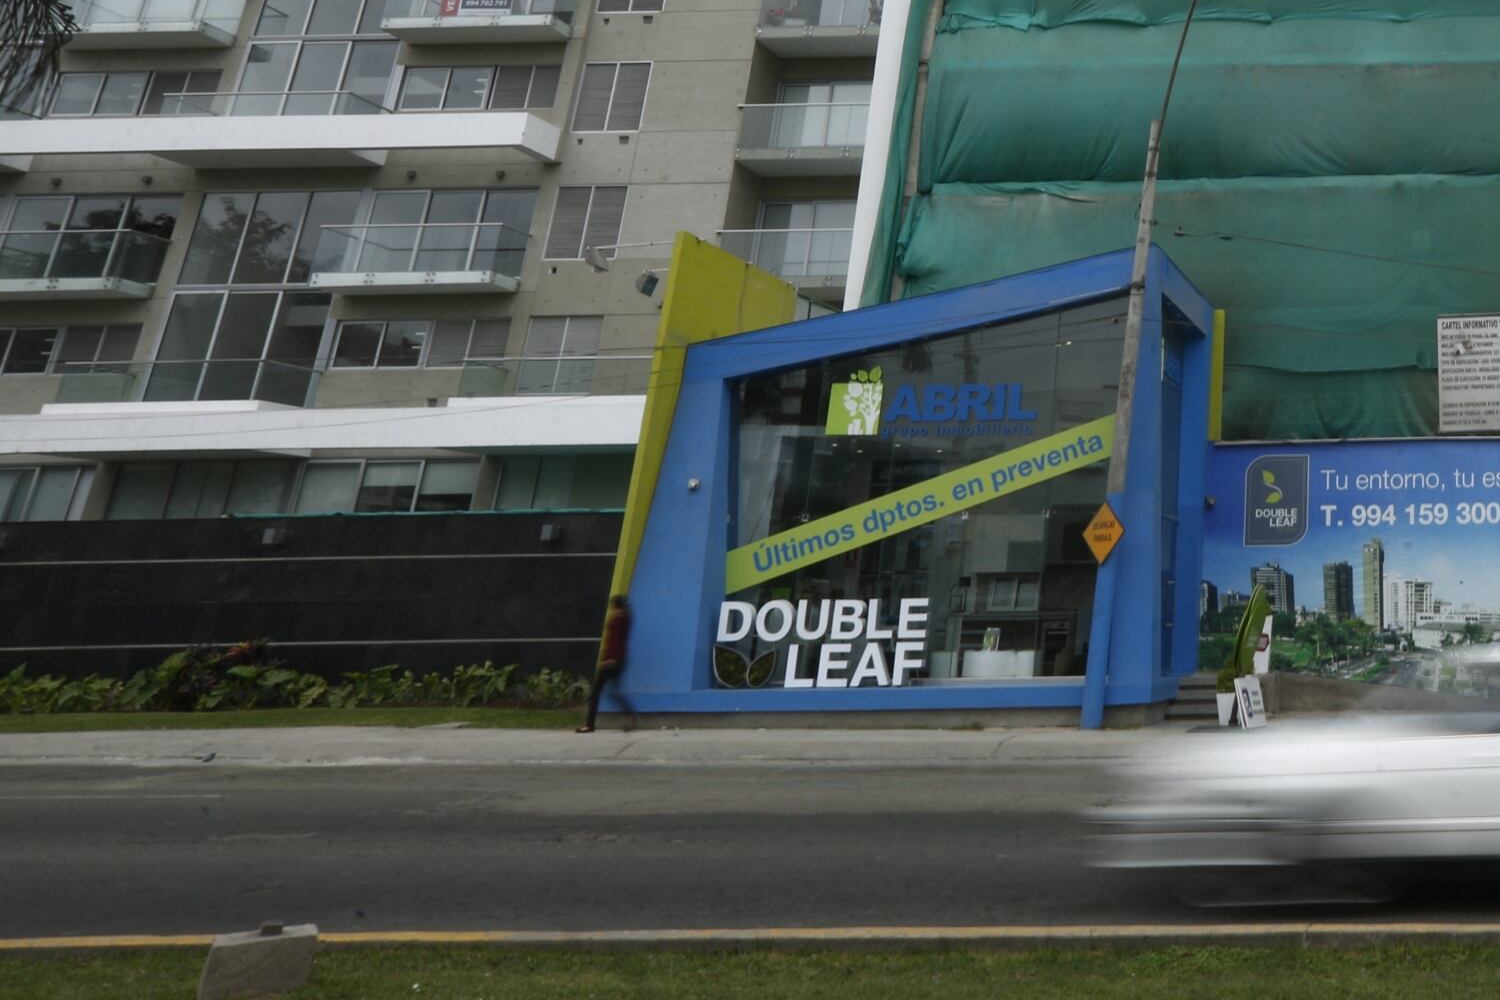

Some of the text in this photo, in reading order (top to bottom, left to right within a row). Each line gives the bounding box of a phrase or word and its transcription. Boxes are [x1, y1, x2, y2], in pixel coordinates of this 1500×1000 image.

[1441, 320, 1461, 330] CARTEL
[1463, 319, 1498, 328] INFORMATIVO
[884, 383, 1037, 422] ABRIL
[881, 423, 1033, 440] grupo inmobiliario
[1320, 469, 1348, 490] Tu
[1356, 469, 1446, 492] entorno,
[1454, 468, 1475, 488] tu
[753, 434, 1103, 573] Últimos dptos. en preventa
[1255, 508, 1298, 518] DOUBLE
[1320, 502, 1500, 527] T. 994 159 300
[1269, 518, 1298, 527] LEAF
[716, 597, 930, 642] DOUBLE
[784, 641, 926, 688] LEAF
